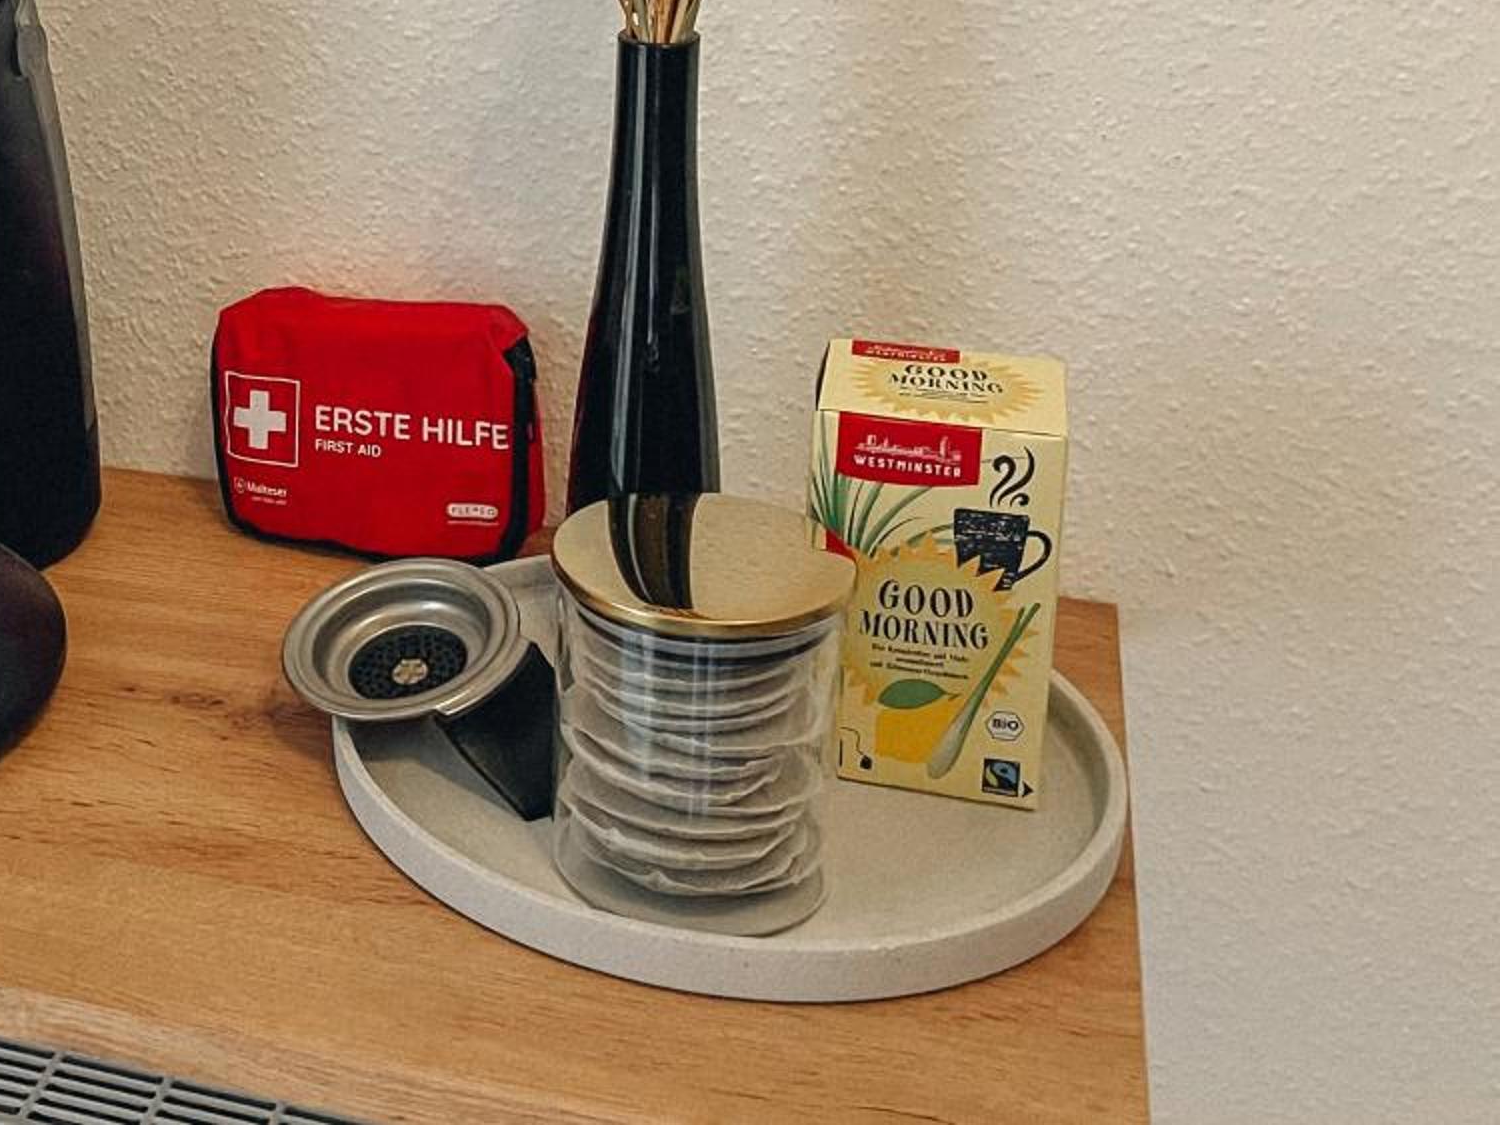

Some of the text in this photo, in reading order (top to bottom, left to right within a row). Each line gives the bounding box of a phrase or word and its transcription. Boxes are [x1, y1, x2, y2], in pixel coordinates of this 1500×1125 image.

[889, 373, 1004, 394] MORNING
[905, 364, 988, 382] GOOD
[314, 404, 510, 450] ERSTE HILFE
[314, 438, 382, 458] FIRST AID
[853, 454, 962, 478] WESTMINSTER
[878, 578, 975, 618] GOOD
[858, 609, 989, 650] MORNING
